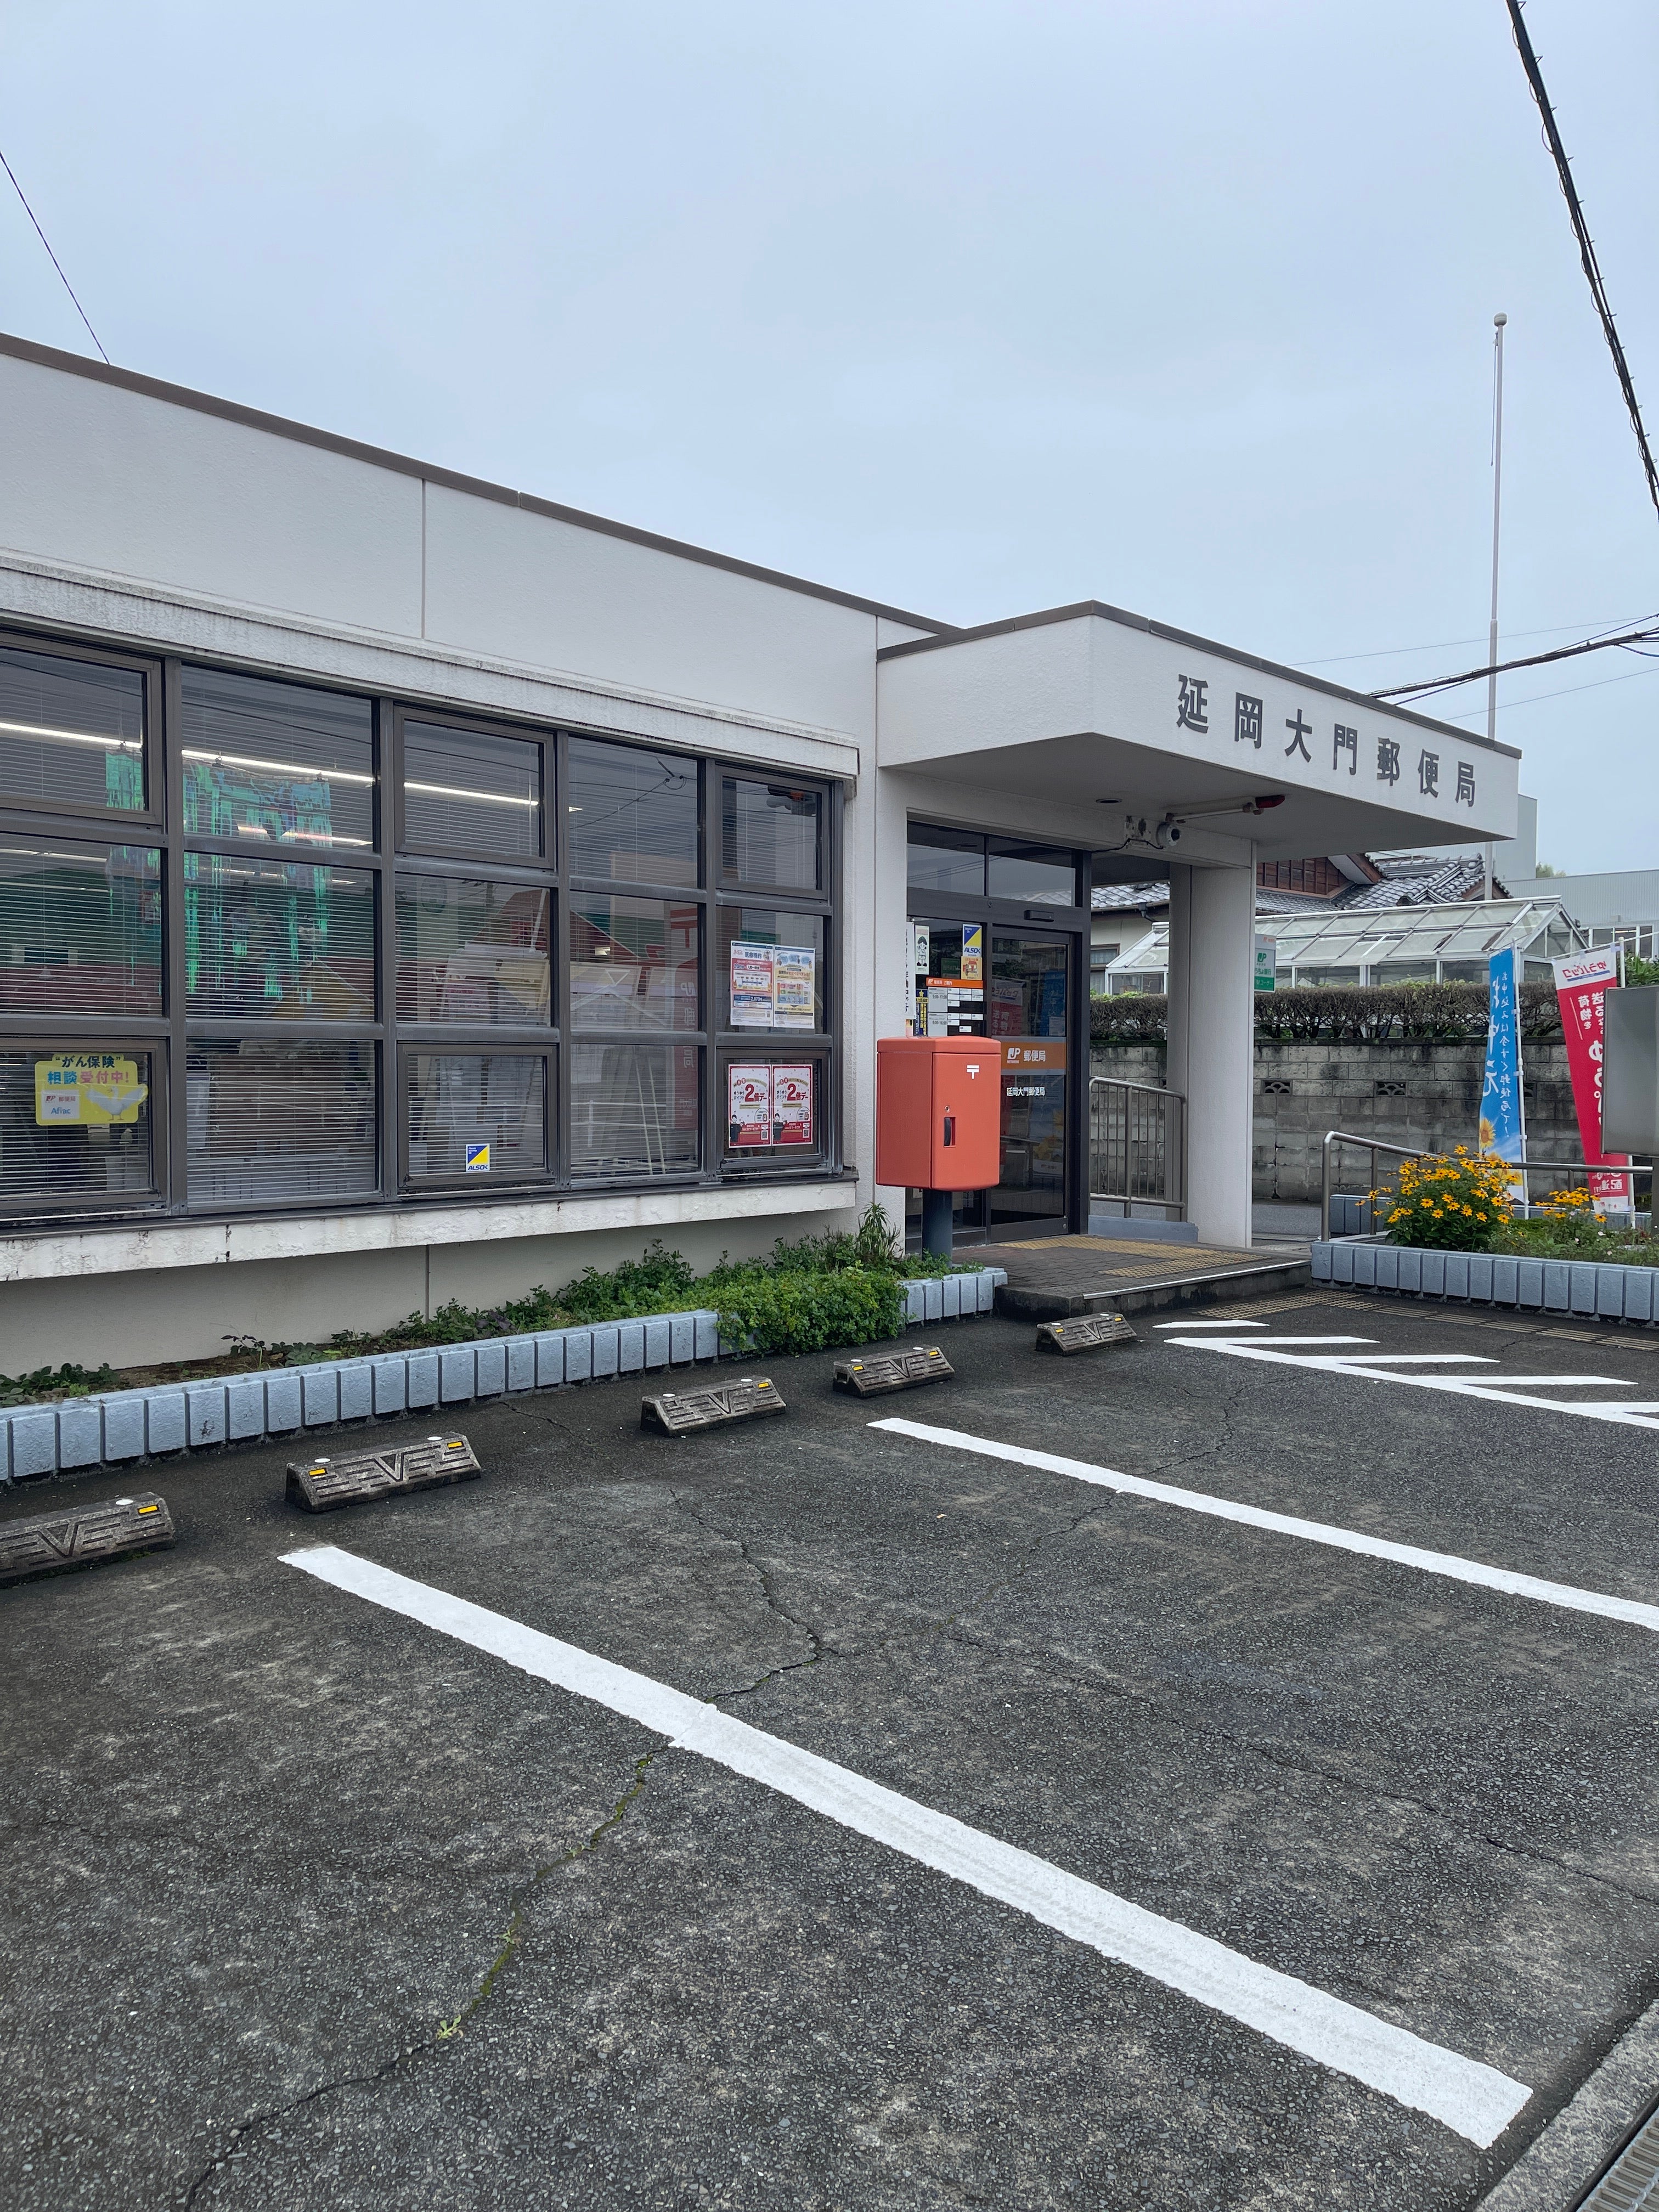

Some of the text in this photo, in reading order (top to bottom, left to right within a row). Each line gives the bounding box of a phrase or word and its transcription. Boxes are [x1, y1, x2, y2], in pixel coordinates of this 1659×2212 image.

[1176, 674, 1475, 807] 延岡大門郵便局
[1024, 1050, 1046, 1062] 郵便局
[1007, 1087, 1045, 1096] 延岡大門郵便局
